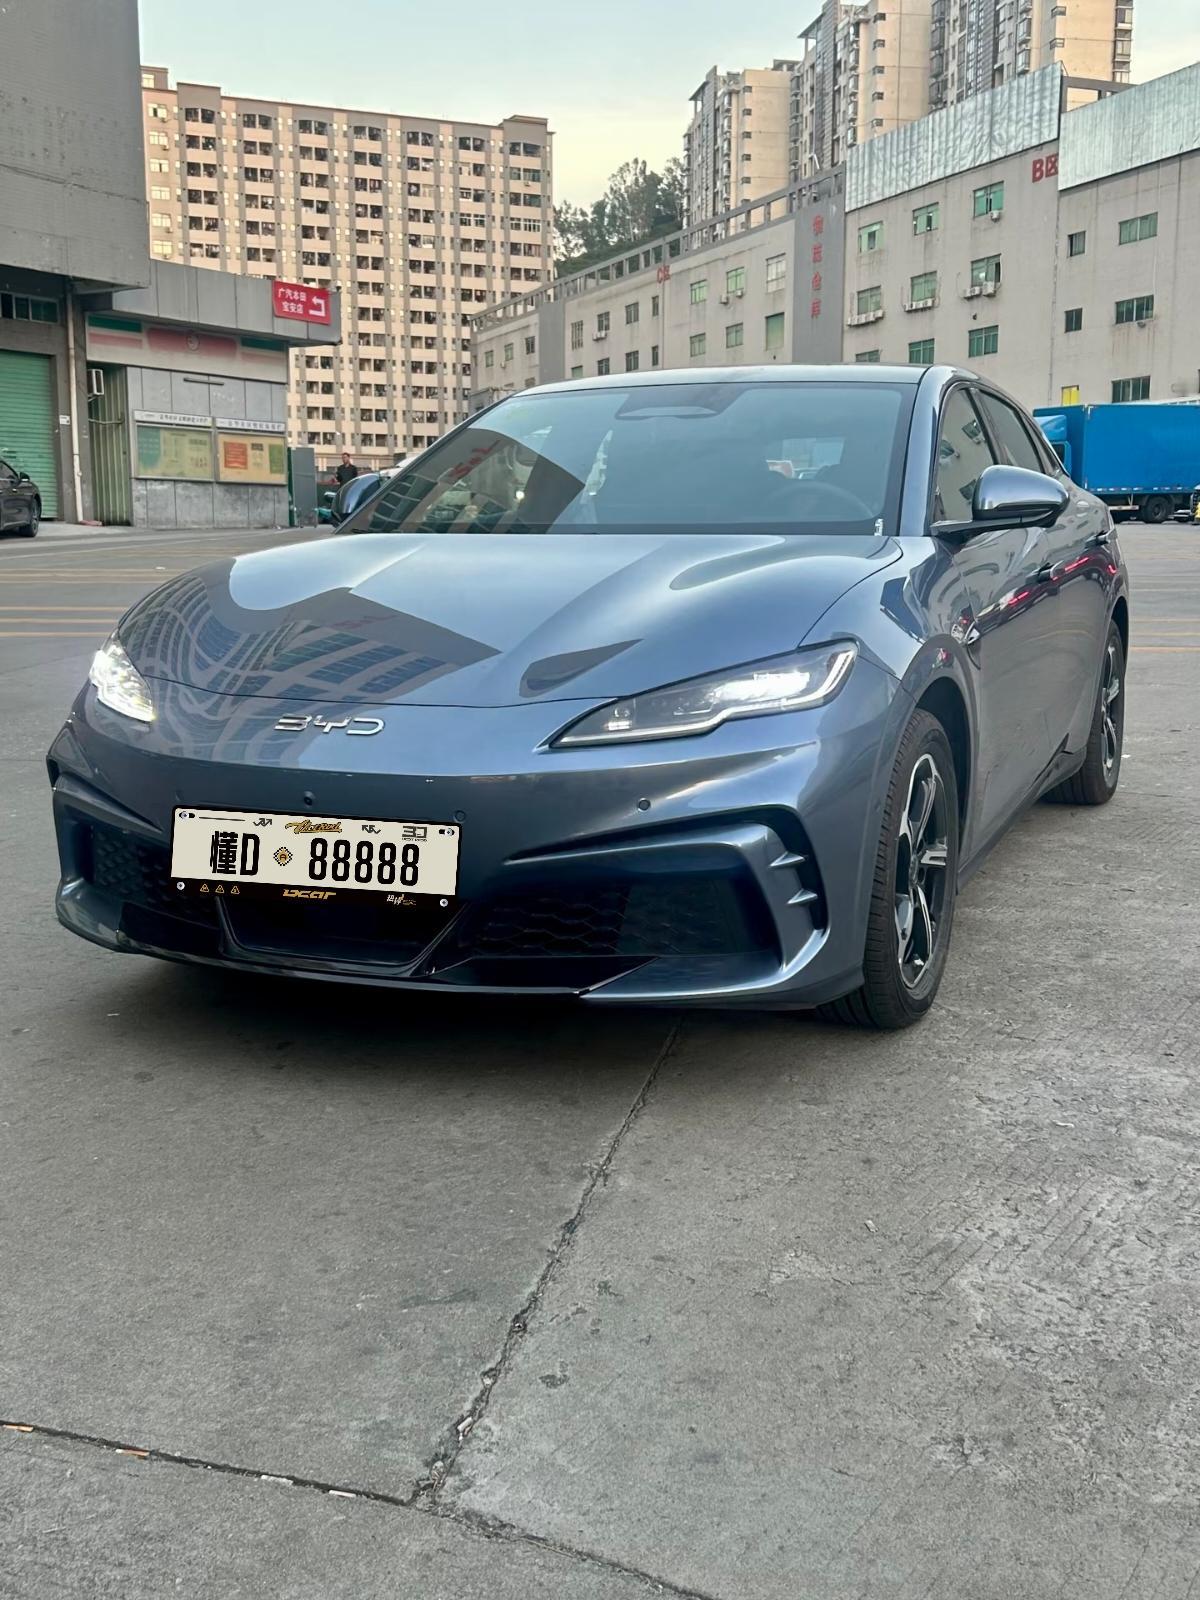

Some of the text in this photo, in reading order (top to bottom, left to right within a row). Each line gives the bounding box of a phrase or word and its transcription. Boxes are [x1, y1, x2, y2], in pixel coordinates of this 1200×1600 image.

[1032, 153, 1059, 184] B区
[278, 287, 307, 302] 广汽本田
[282, 301, 304, 314] 宝安店
[274, 714, 385, 735] BYD
